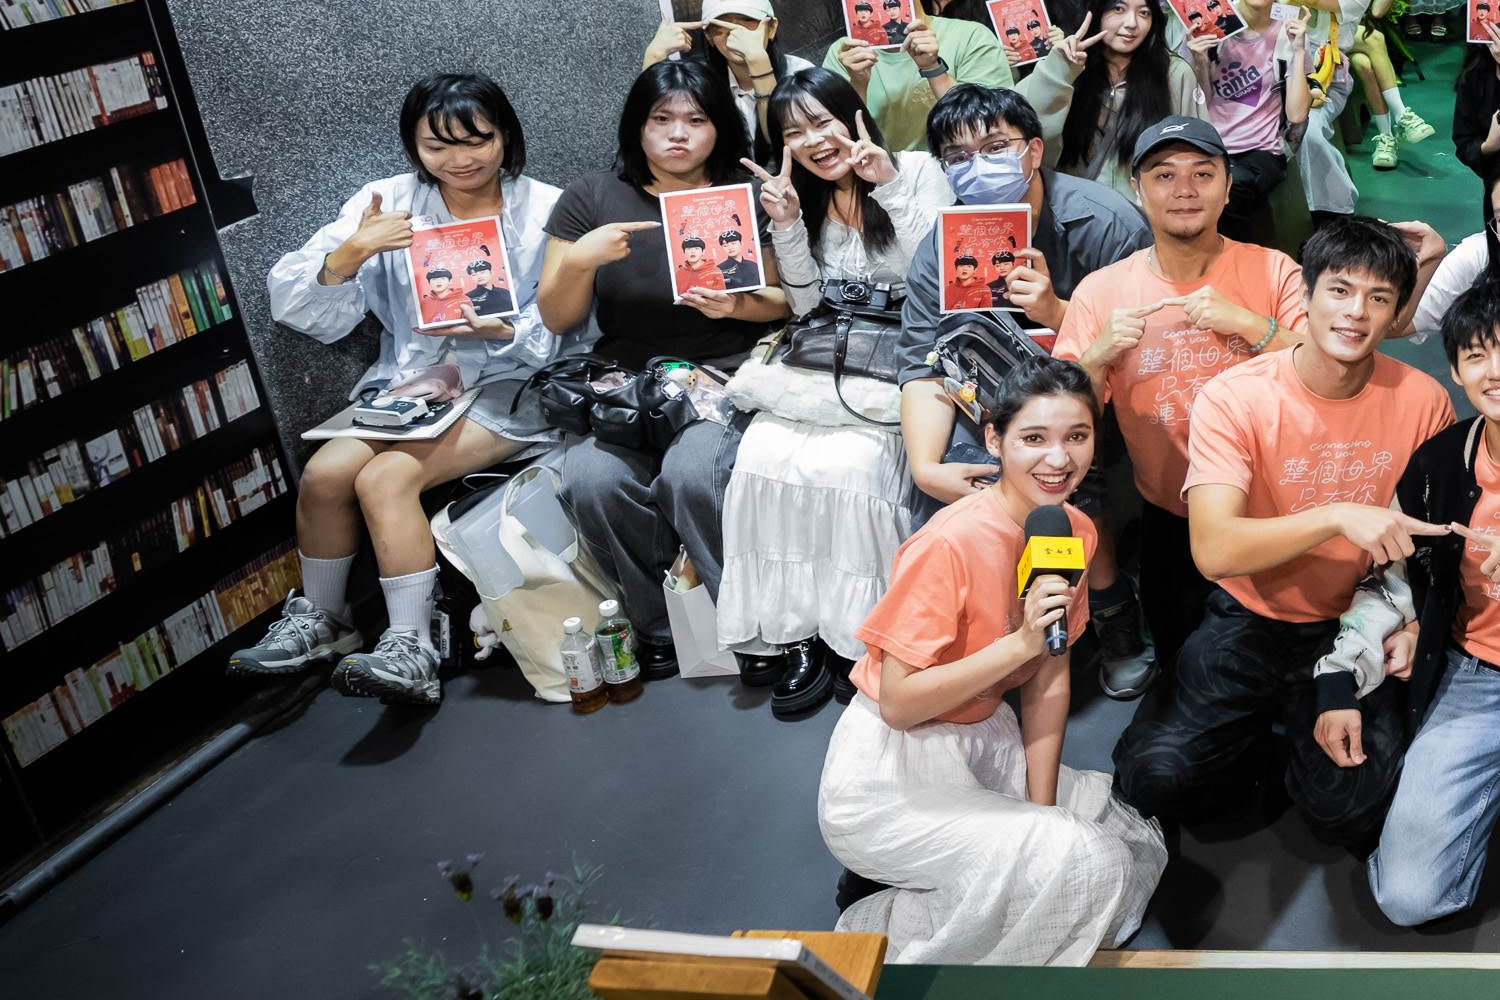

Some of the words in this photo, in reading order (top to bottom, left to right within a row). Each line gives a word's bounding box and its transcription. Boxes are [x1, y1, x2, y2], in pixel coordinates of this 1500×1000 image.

[1213, 64, 1261, 98] Fanta
[1138, 334, 1247, 375] 整個世界
[1279, 450, 1393, 486] 整個世界
